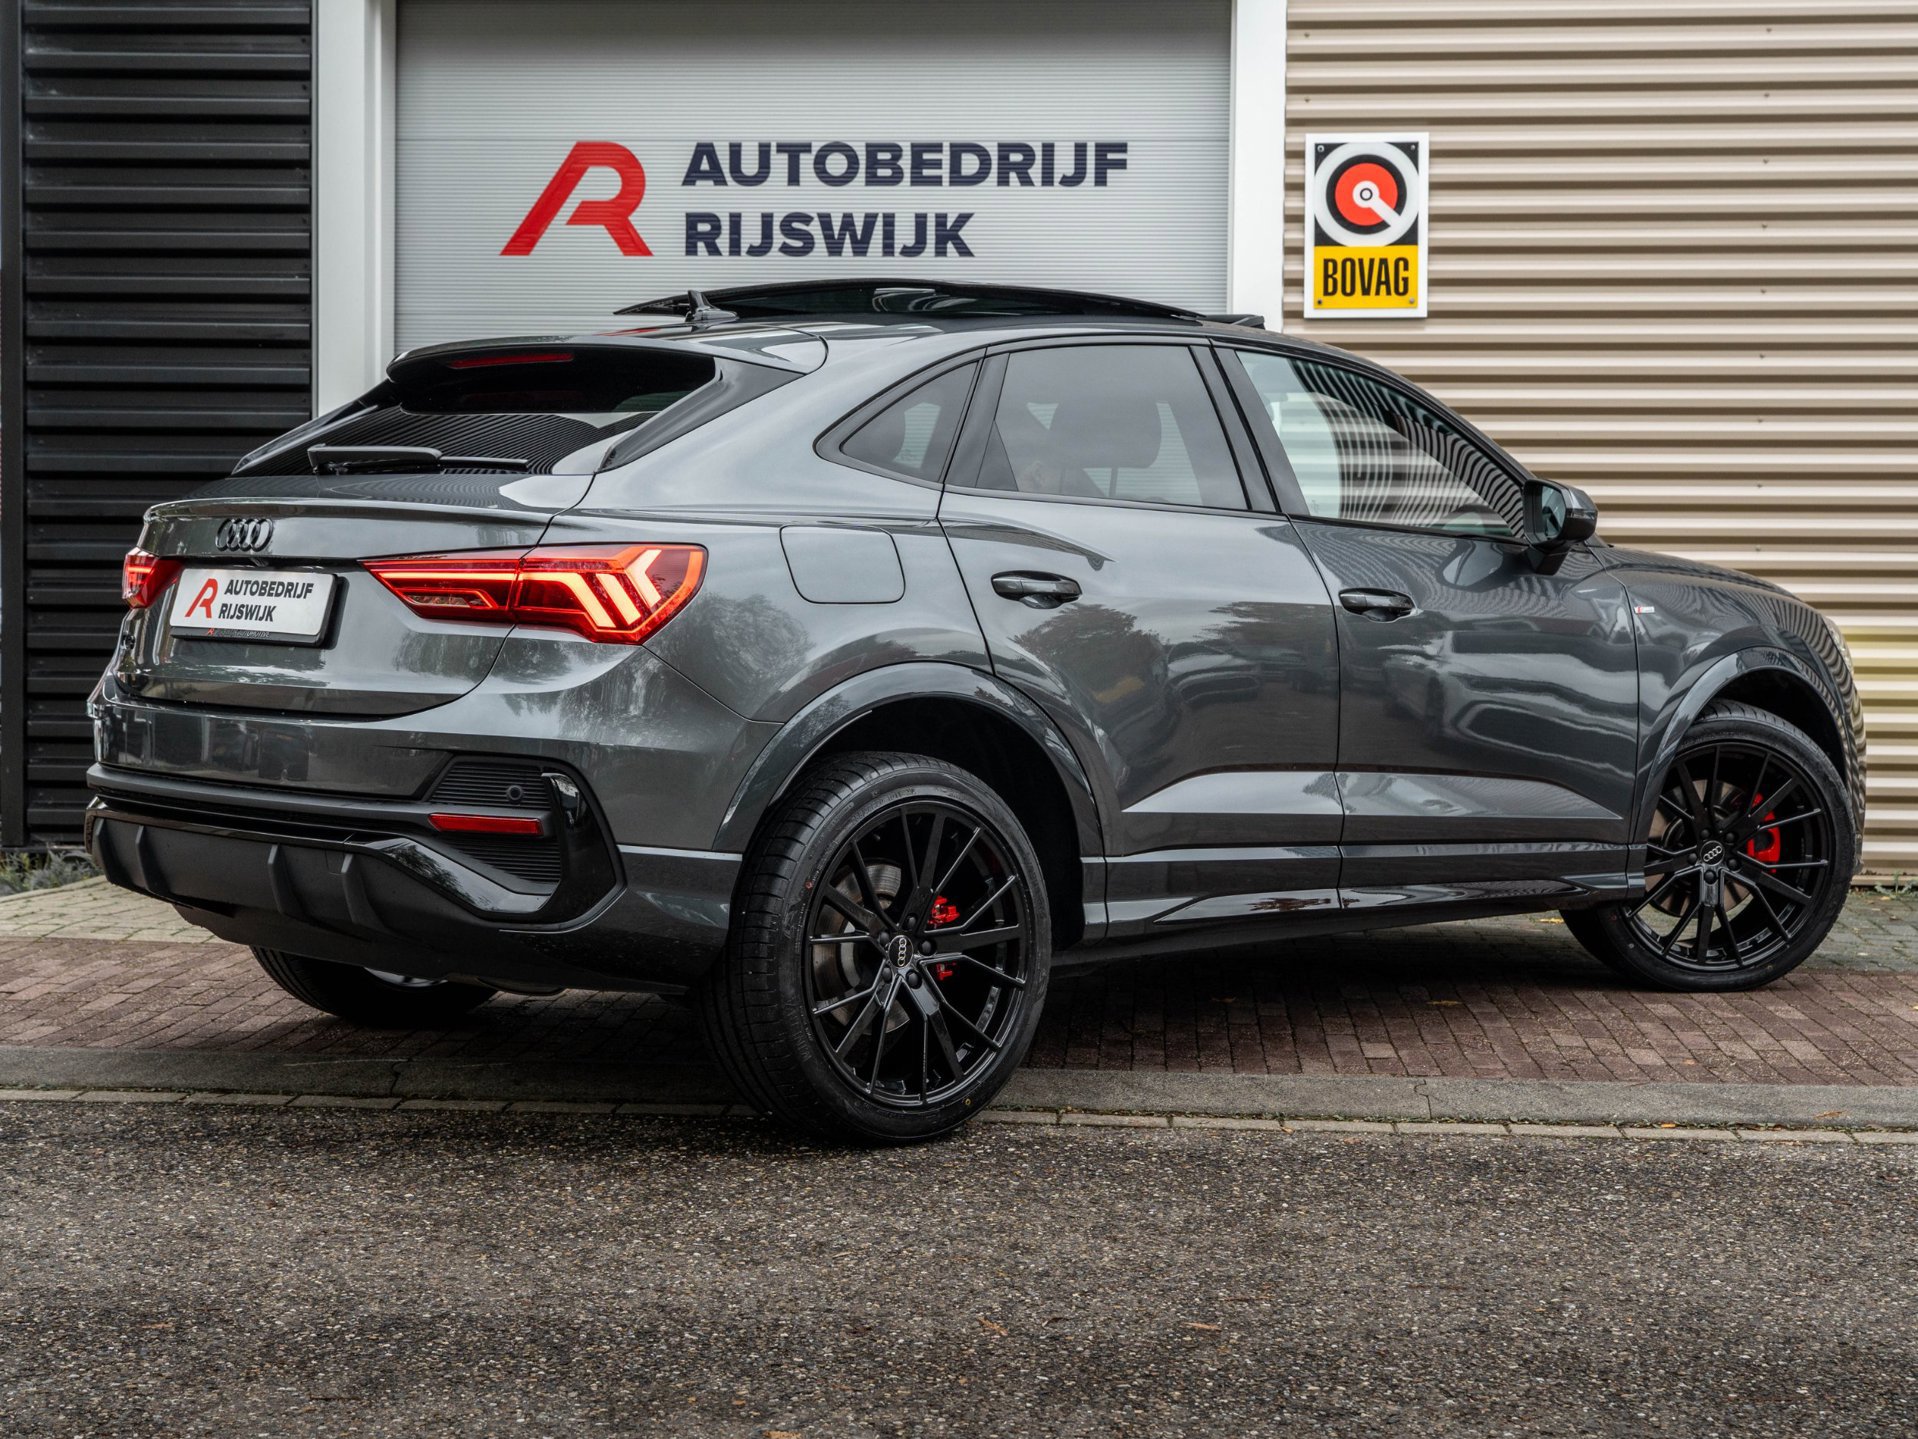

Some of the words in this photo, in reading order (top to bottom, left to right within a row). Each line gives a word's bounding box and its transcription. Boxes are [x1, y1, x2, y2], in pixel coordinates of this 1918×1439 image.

[682, 141, 1128, 187] AUTOBEDRIJF
[685, 212, 975, 257] RIJSWIJK
[1323, 257, 1409, 297] BOVAG
[224, 579, 314, 600] AUTOBEDRIJF
[218, 603, 277, 622] RIJSWIJK
